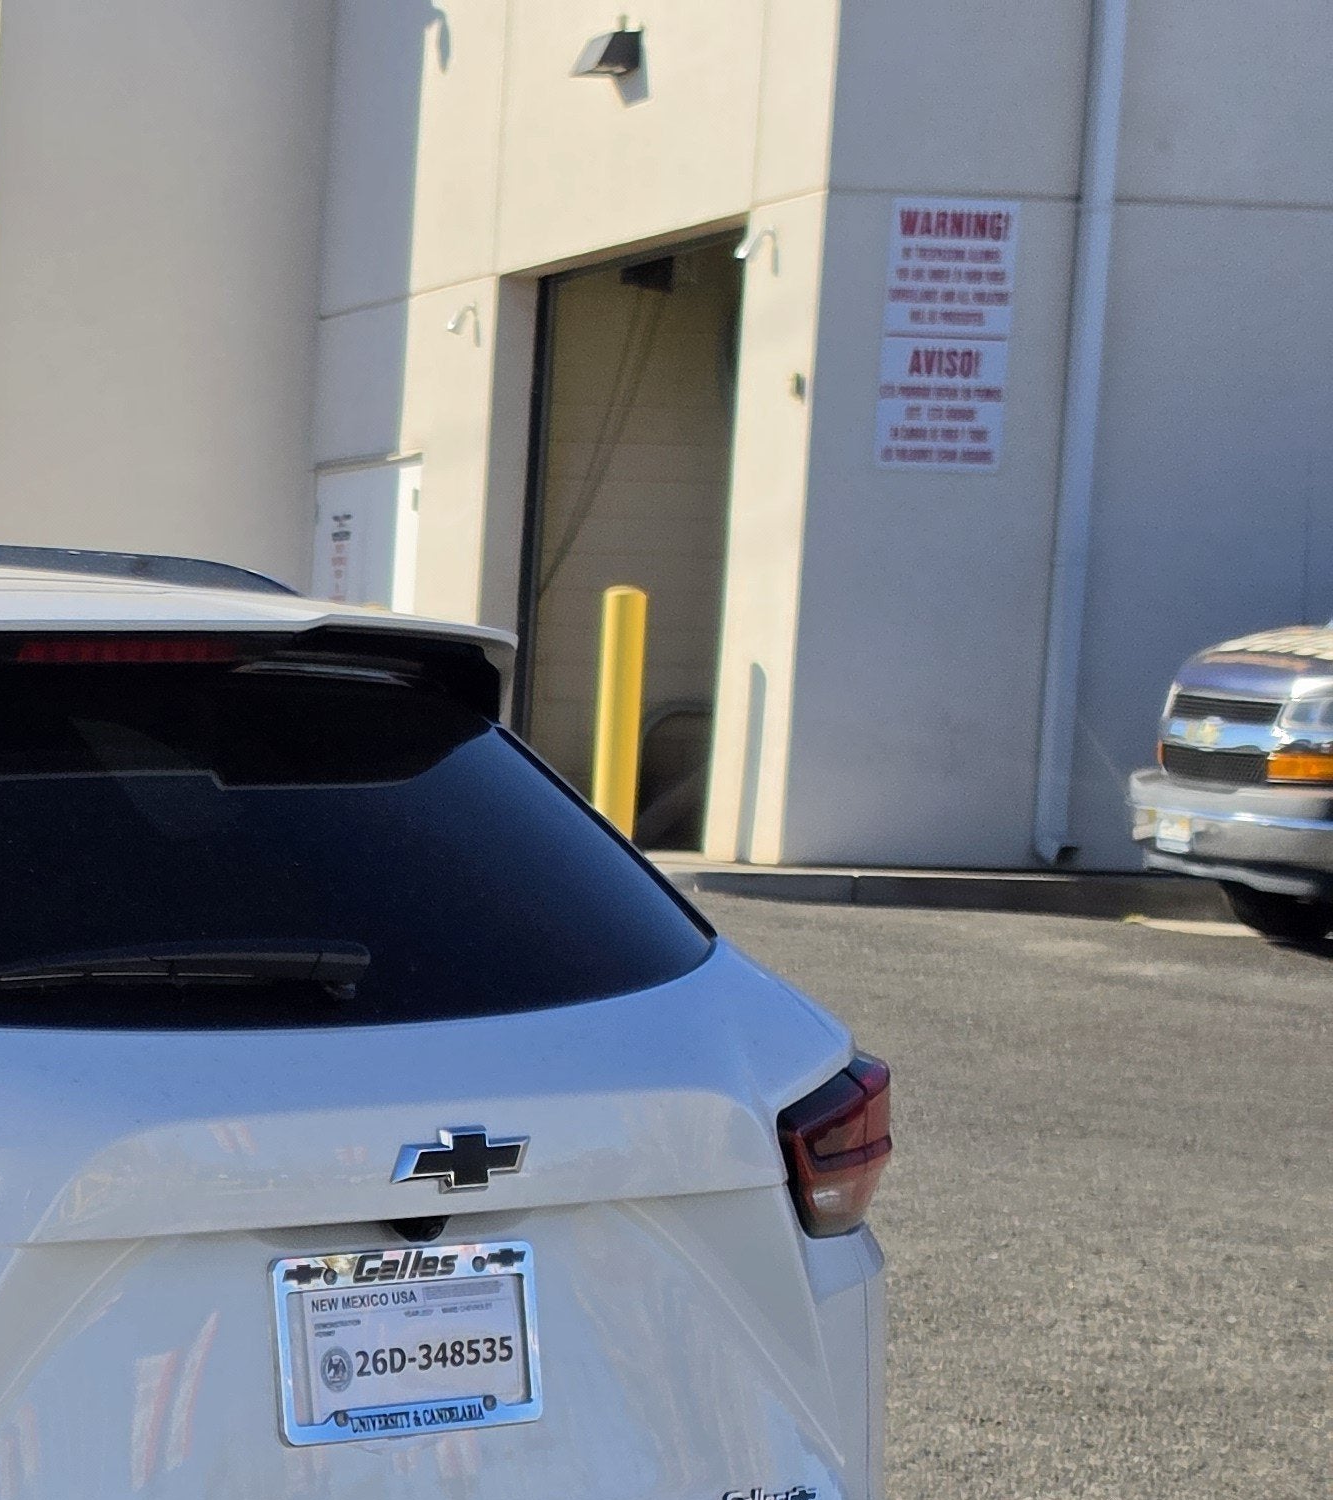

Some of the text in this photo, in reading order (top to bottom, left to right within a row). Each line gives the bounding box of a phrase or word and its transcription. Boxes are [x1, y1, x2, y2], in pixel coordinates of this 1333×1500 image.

[900, 209, 1011, 240] WARNING!
[908, 348, 982, 378] AVISO!
[353, 1250, 459, 1283] Galles
[311, 1297, 339, 1313] NEW
[341, 1293, 390, 1310] MEXICO
[391, 1289, 417, 1305] USA
[355, 1335, 514, 1378] 26D-348535
[351, 1403, 486, 1434] UNIVERSITY & CANDELARIA
